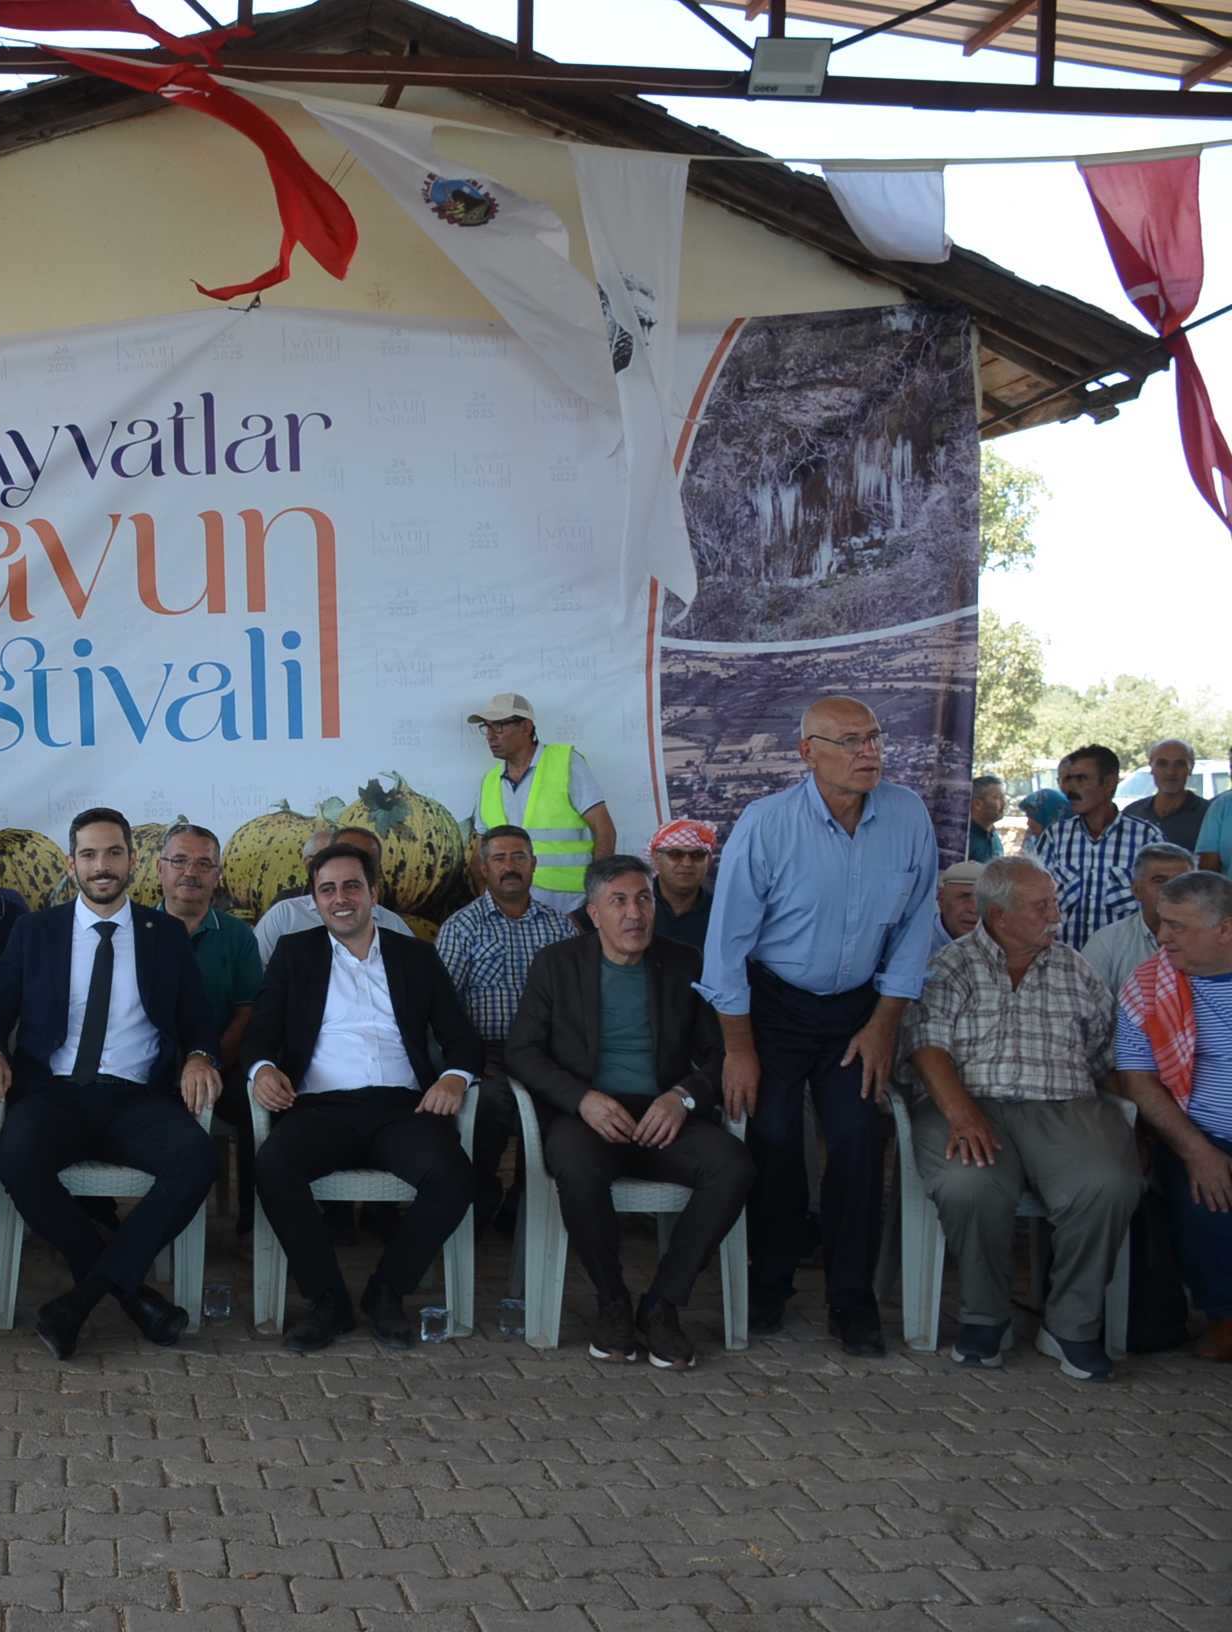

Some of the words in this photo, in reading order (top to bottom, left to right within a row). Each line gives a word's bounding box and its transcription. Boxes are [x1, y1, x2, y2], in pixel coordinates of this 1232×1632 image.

[220, 332, 234, 342] 24
[388, 329, 401, 338] 24
[55, 345, 68, 354] 24
[381, 345, 410, 355] 2025
[213, 350, 242, 360] 2025
[48, 362, 76, 372] 2025
[472, 391, 486, 401] 24
[465, 409, 494, 419] 2025
[392, 458, 406, 468] 24
[556, 454, 569, 464] 24
[385, 476, 414, 486] 2025
[550, 472, 578, 482] 2025
[477, 521, 490, 531] 24
[470, 539, 498, 549] 2025
[395, 589, 409, 598] 24
[560, 584, 573, 594] 24
[388, 606, 417, 616] 2025
[553, 602, 582, 612] 2025
[480, 652, 493, 661] 24
[473, 669, 502, 679] 2025
[399, 719, 412, 728] 24
[563, 714, 576, 723] 24
[392, 736, 420, 746] 2025
[557, 731, 584, 741] 2025
